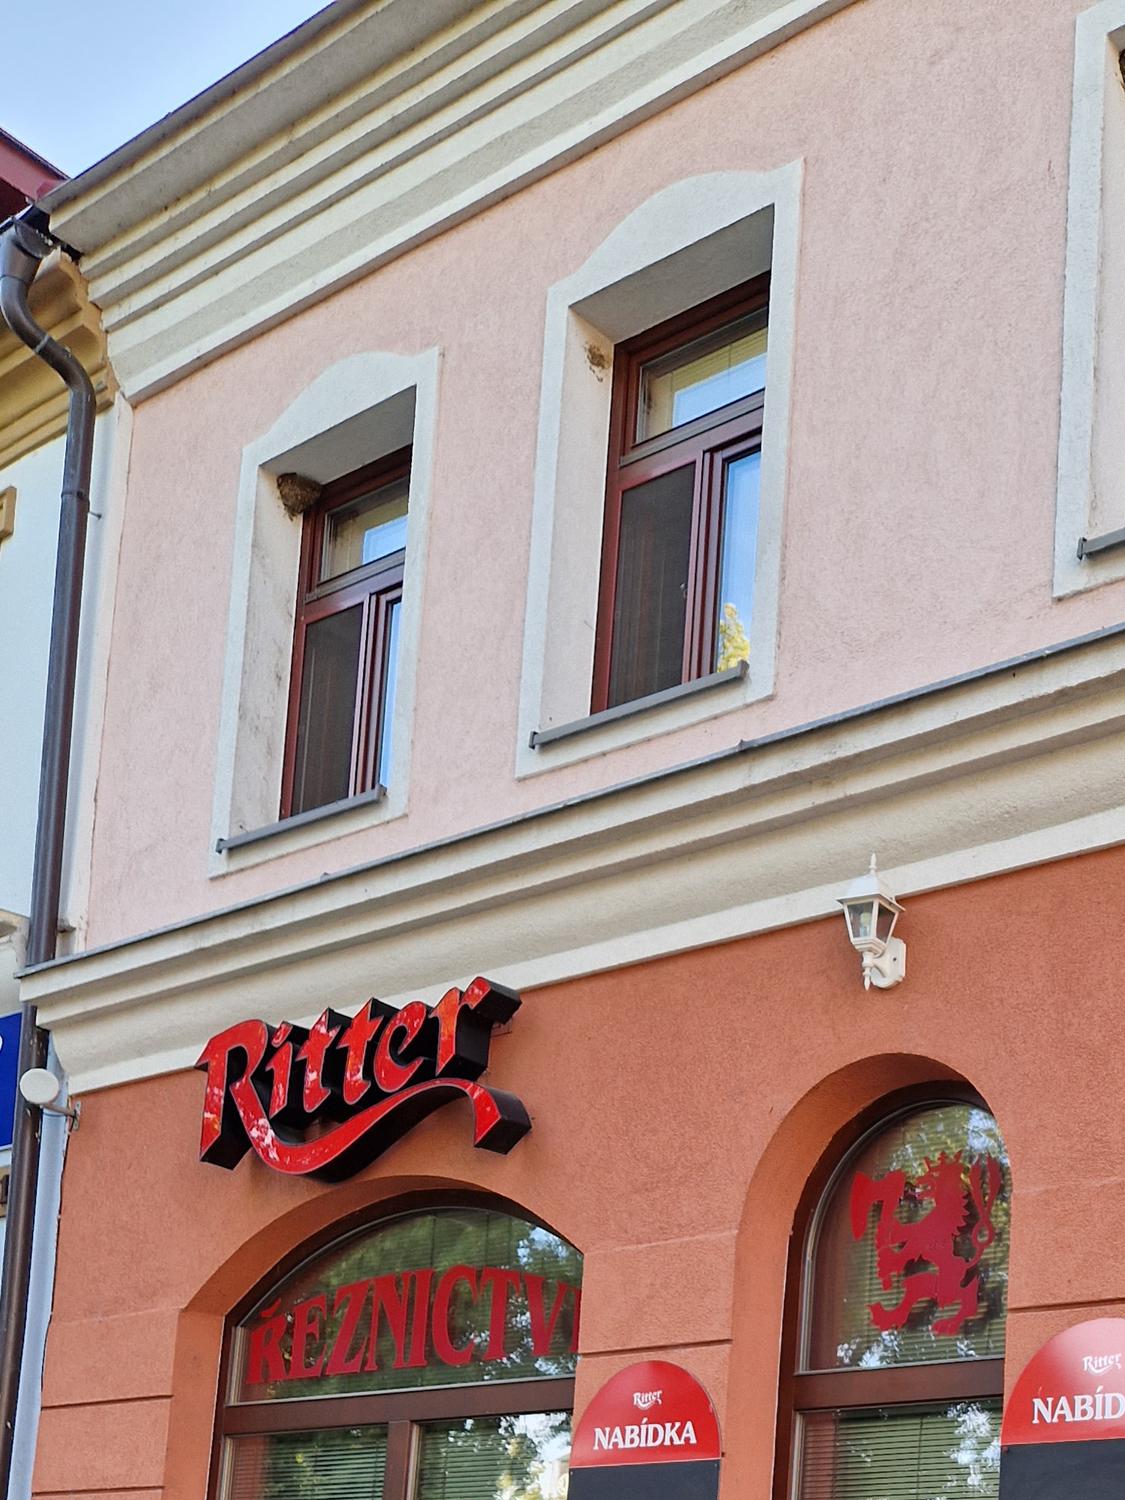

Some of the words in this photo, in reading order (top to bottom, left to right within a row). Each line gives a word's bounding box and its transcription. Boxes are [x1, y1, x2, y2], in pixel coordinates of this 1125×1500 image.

[194, 976, 530, 1181] Ritter
[1082, 1353, 1122, 1376] Ritter
[633, 1390, 663, 1410] Ritter
[593, 1417, 697, 1450] NABÍDKA
